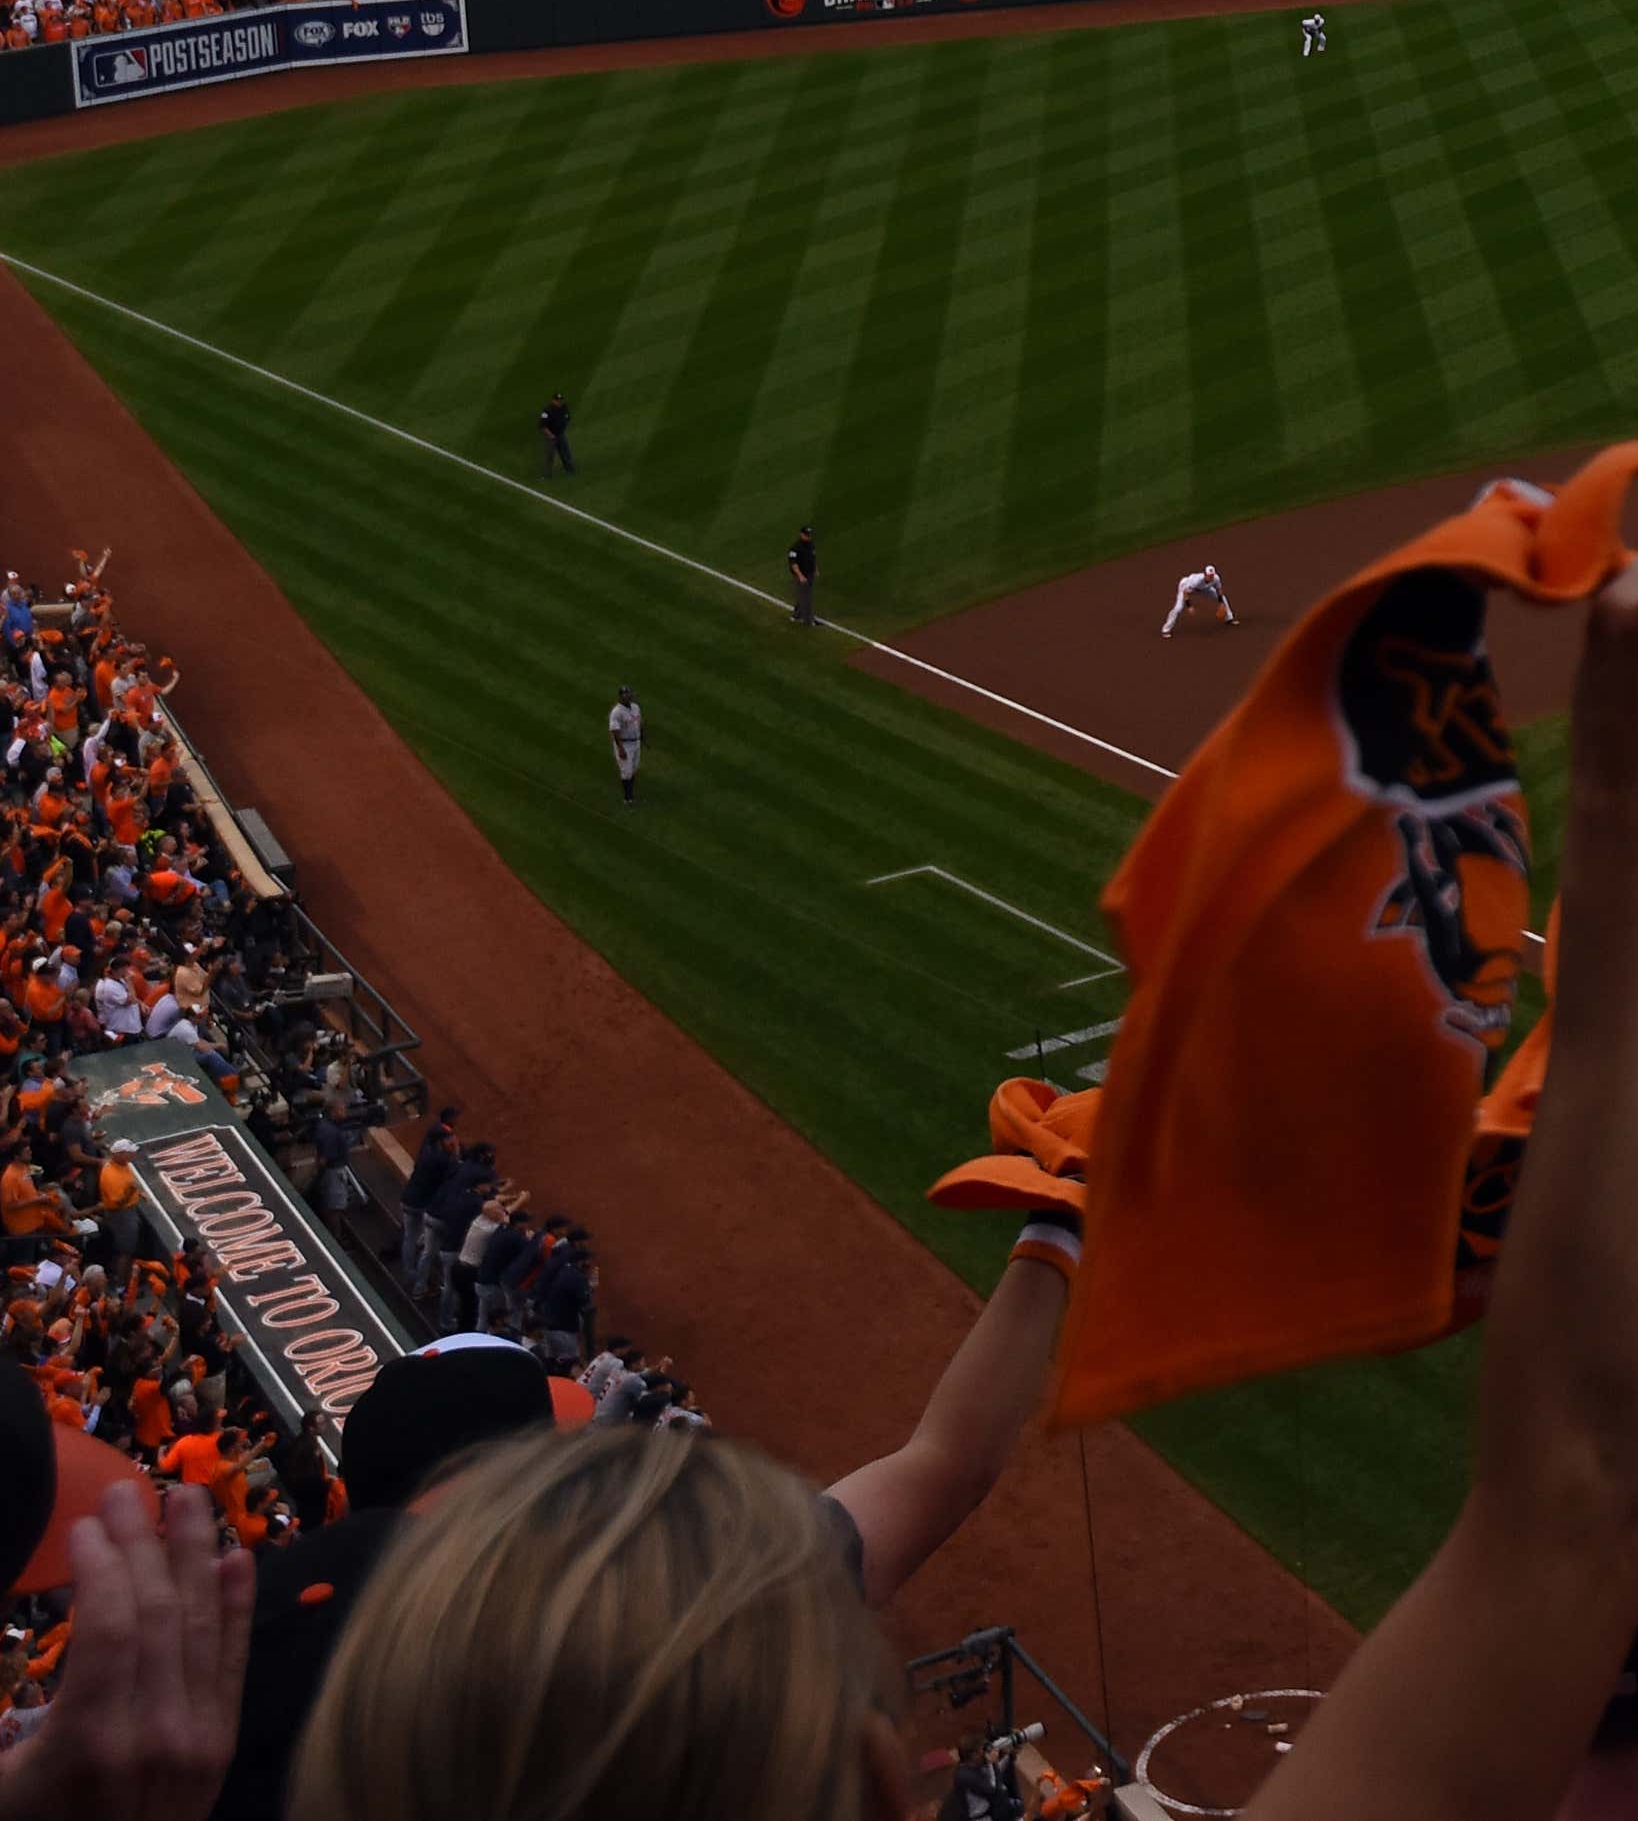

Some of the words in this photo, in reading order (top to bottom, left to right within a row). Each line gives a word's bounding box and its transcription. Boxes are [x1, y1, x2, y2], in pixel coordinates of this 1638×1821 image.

[342, 20, 381, 39] FOX
[419, 11, 445, 25] tbs
[149, 23, 274, 79] POSTSEASON
[149, 1132, 307, 1282] WELCOME
[247, 1274, 340, 1329] TO
